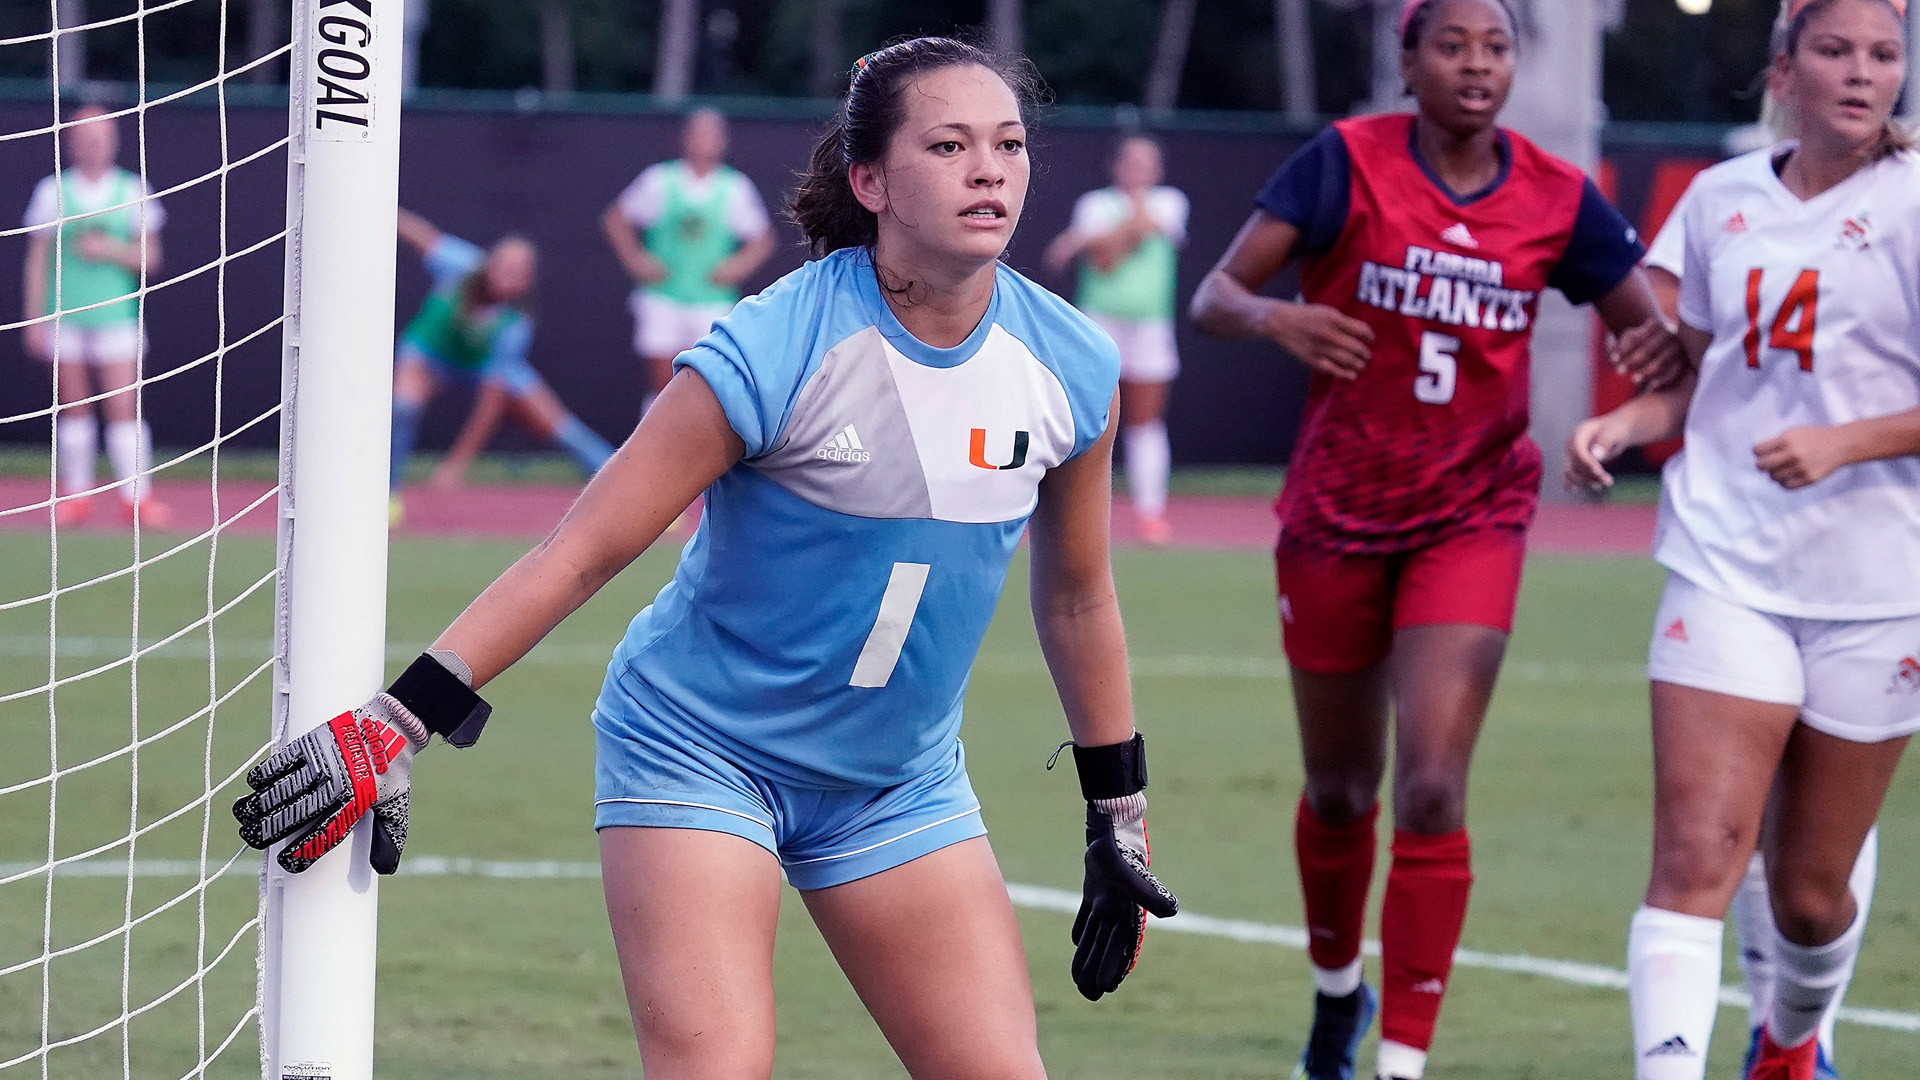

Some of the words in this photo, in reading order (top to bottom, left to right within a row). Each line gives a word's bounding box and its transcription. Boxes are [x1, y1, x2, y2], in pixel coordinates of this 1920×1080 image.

[1744, 267, 1820, 373] 14
[1412, 329, 1461, 405] 5
[816, 447, 871, 463] adidas
[969, 427, 1030, 471] U
[848, 561, 932, 688] 1
[340, 724, 371, 782] PREDATOR
[360, 717, 389, 775] adidas
